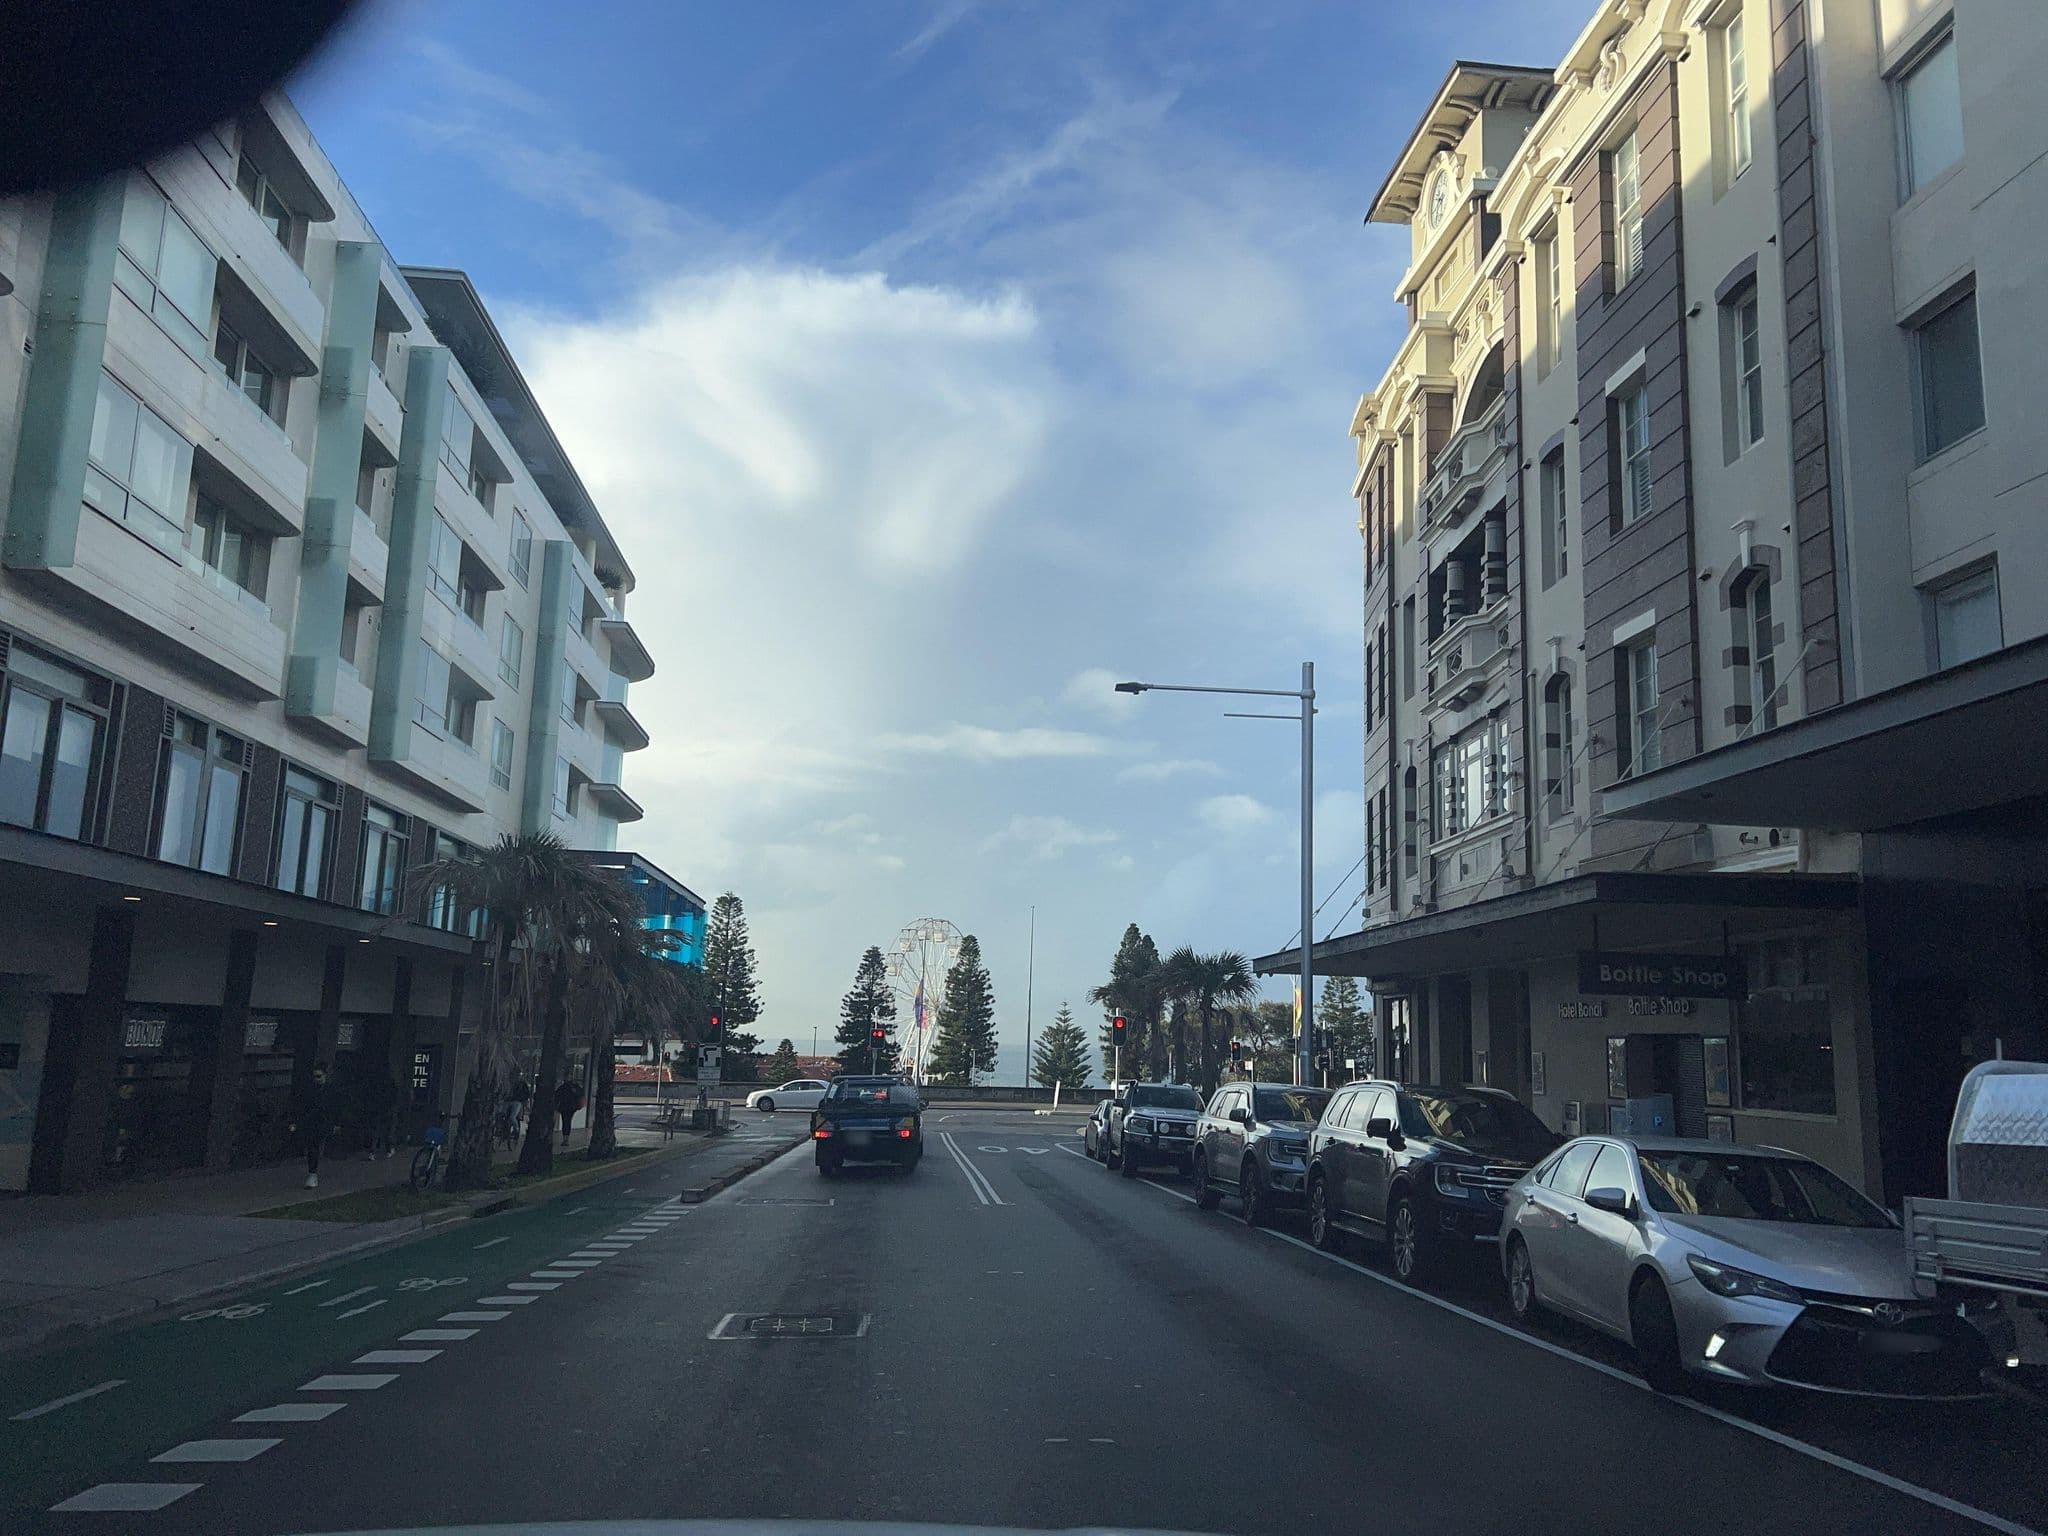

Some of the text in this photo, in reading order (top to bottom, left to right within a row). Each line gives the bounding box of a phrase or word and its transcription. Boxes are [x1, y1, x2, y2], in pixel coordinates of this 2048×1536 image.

[1599, 965, 1729, 989] Bottle Shop
[1557, 1002, 1577, 1018] Hotel
[1628, 996, 1690, 1016] Bottle Shop
[415, 1053, 430, 1063] EN
[414, 1065, 428, 1076] TIL
[412, 1078, 428, 1088] TE
